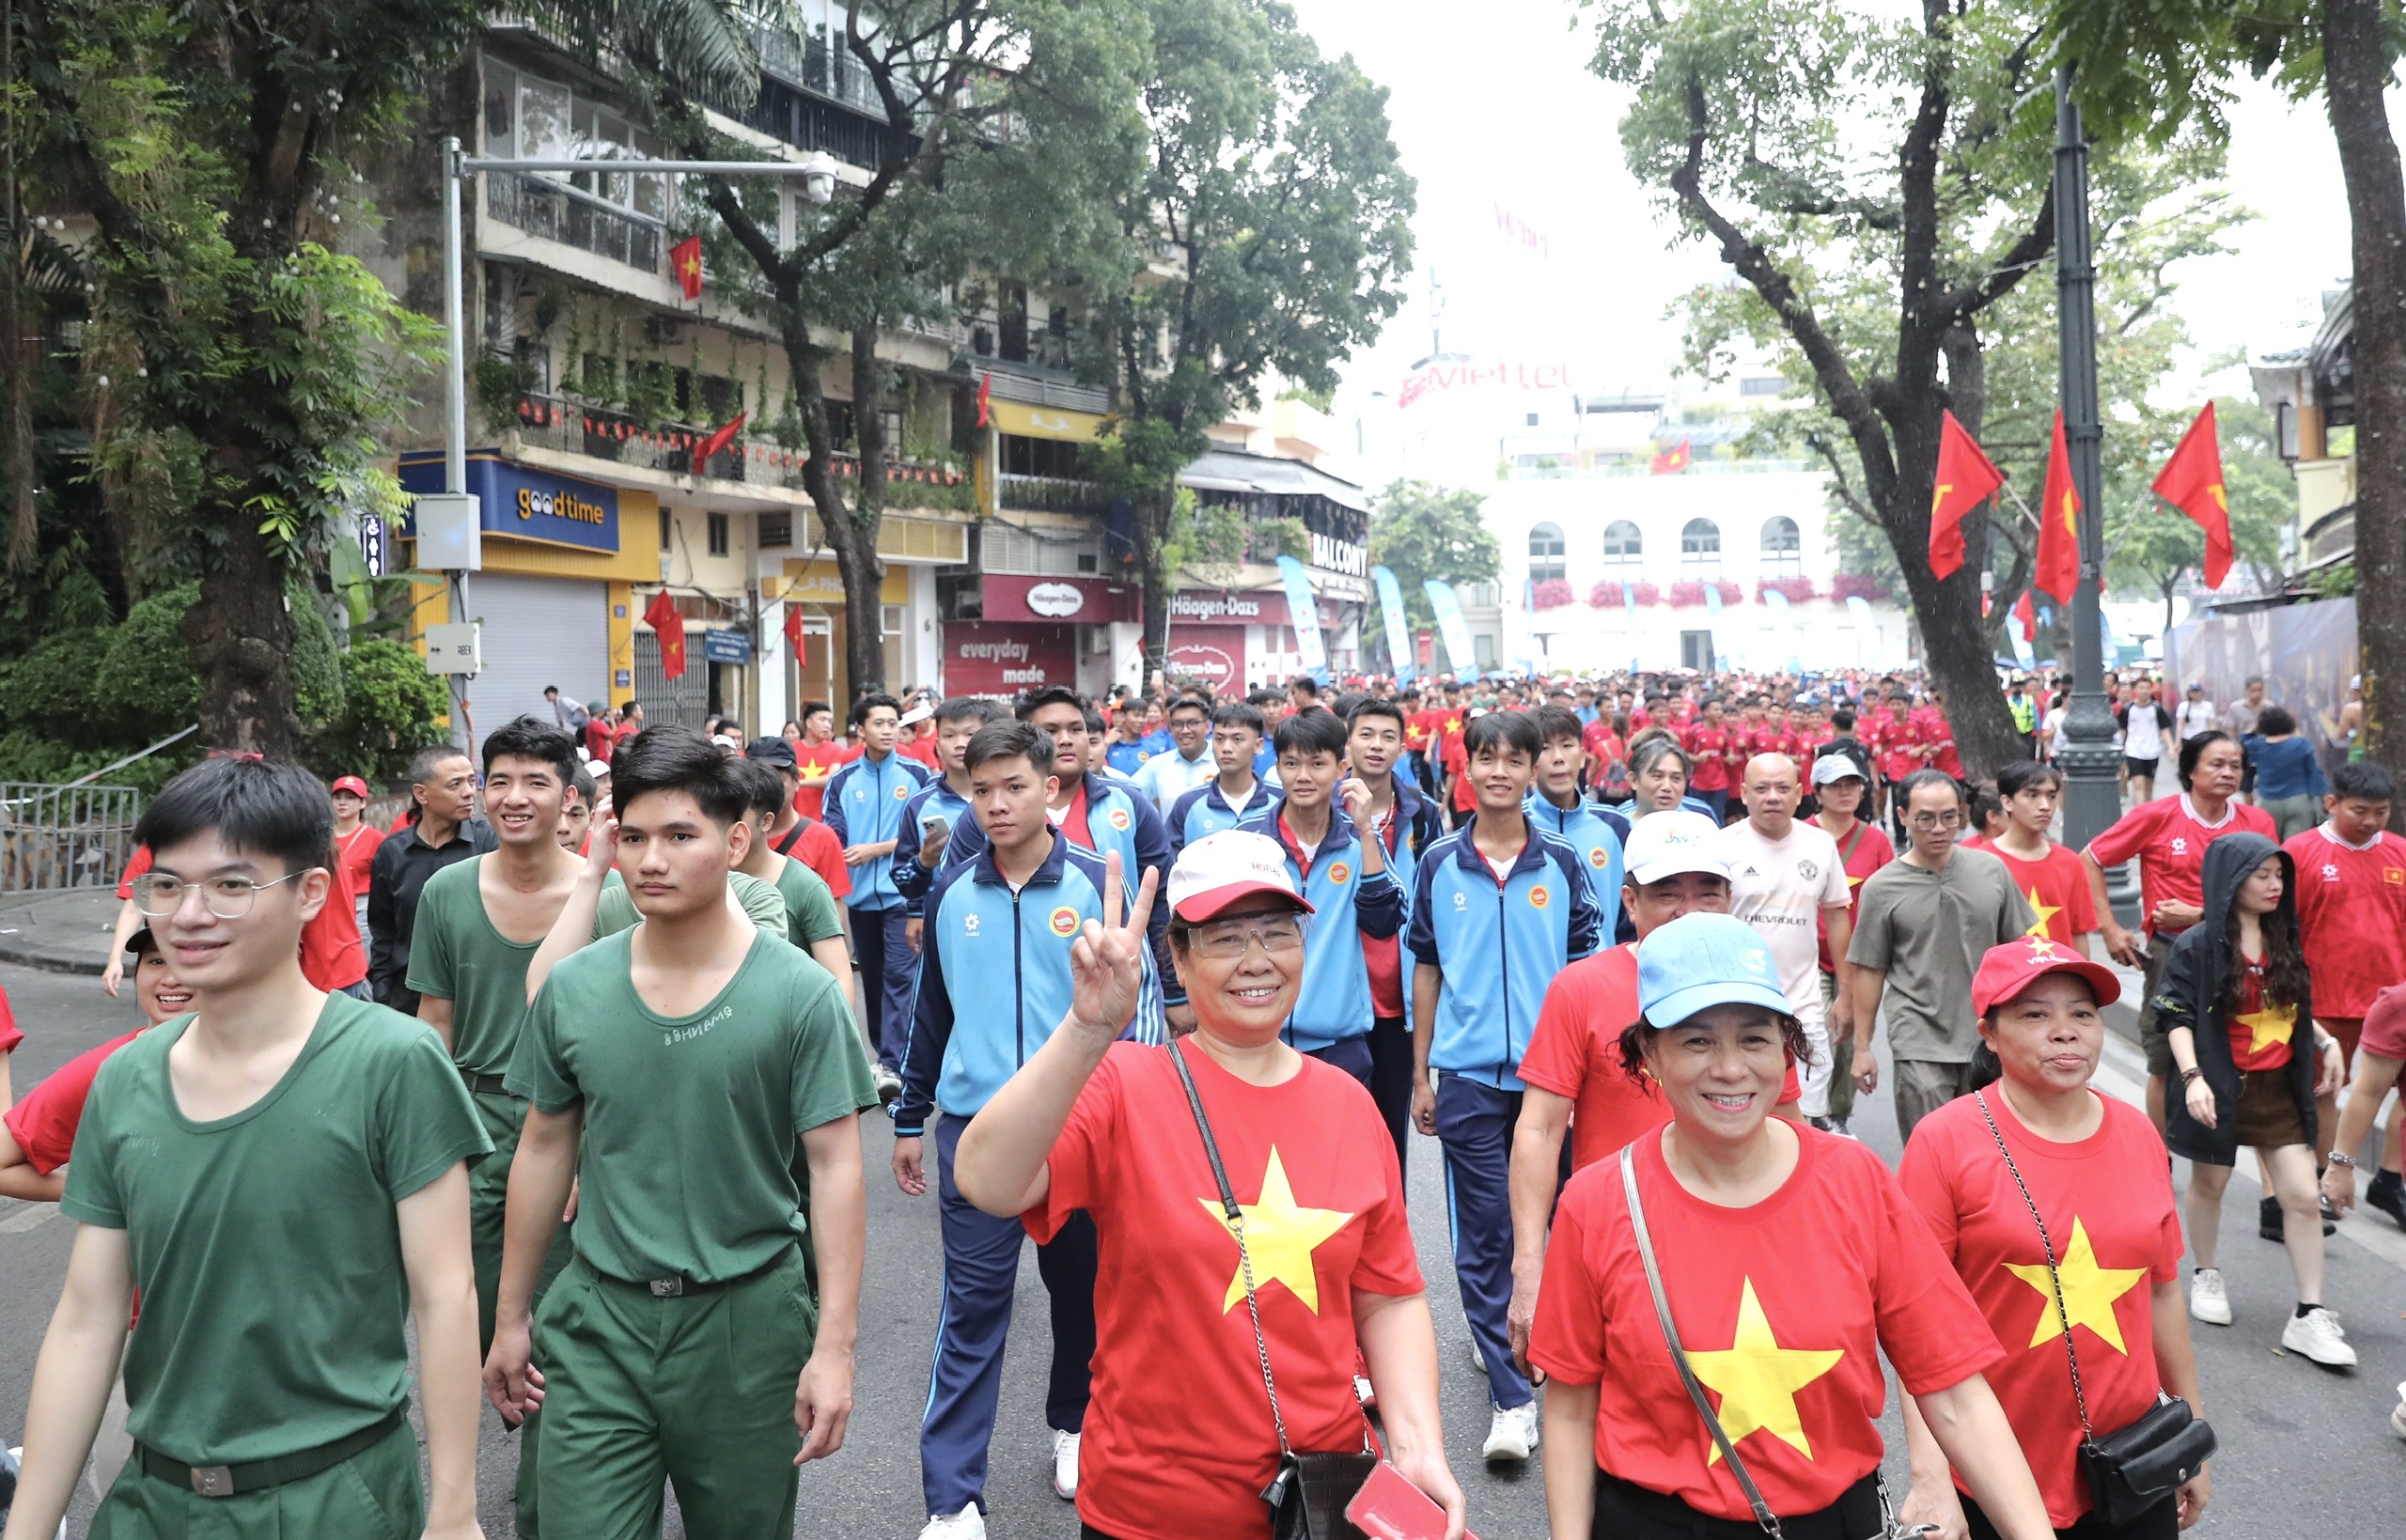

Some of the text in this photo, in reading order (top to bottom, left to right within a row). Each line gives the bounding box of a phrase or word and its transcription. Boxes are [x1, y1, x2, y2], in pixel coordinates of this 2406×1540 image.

[518, 488, 604, 525] goodtime
[1312, 532, 1369, 578] BALCONY
[1171, 594, 1259, 621] Häagen-Dazs
[960, 638, 1030, 662] everyday
[1002, 663, 1046, 684] made
